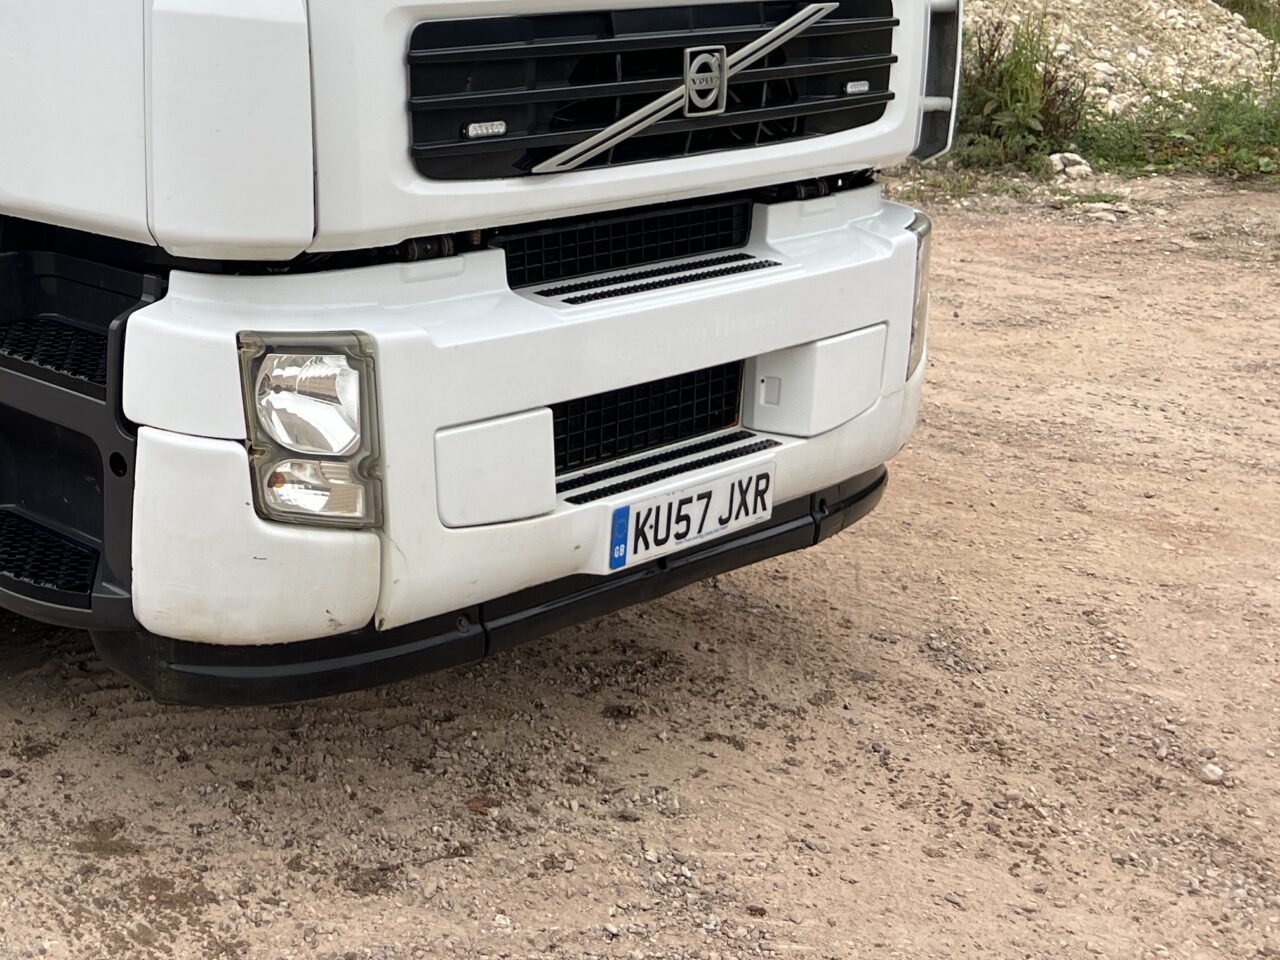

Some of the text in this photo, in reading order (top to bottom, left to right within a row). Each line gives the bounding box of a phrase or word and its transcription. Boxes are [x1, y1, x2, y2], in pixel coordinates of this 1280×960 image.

[632, 472, 771, 555] KU57 JXR
[613, 543, 626, 559] GB
